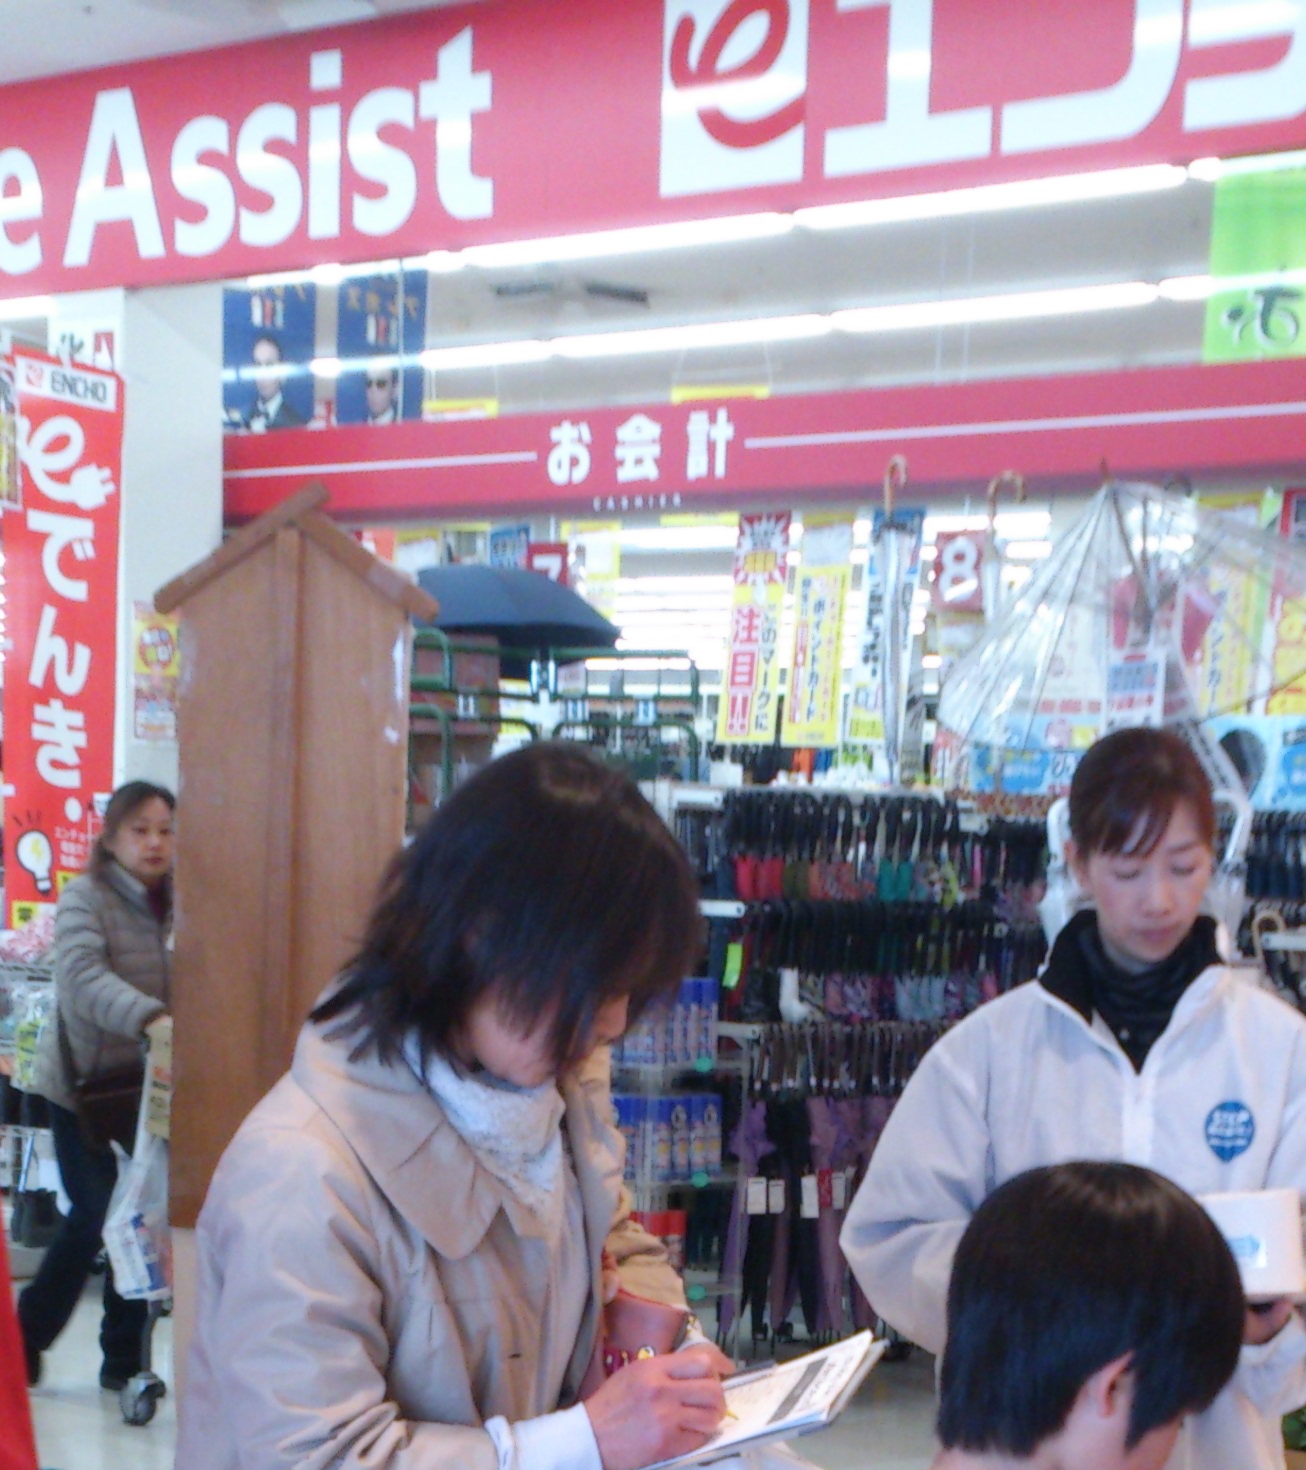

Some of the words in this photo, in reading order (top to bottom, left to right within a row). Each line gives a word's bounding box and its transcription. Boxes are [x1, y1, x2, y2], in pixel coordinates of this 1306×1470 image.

[63, 25, 494, 268] Assist
[50, 373, 109, 405] ENCHO
[547, 407, 735, 485] お会計
